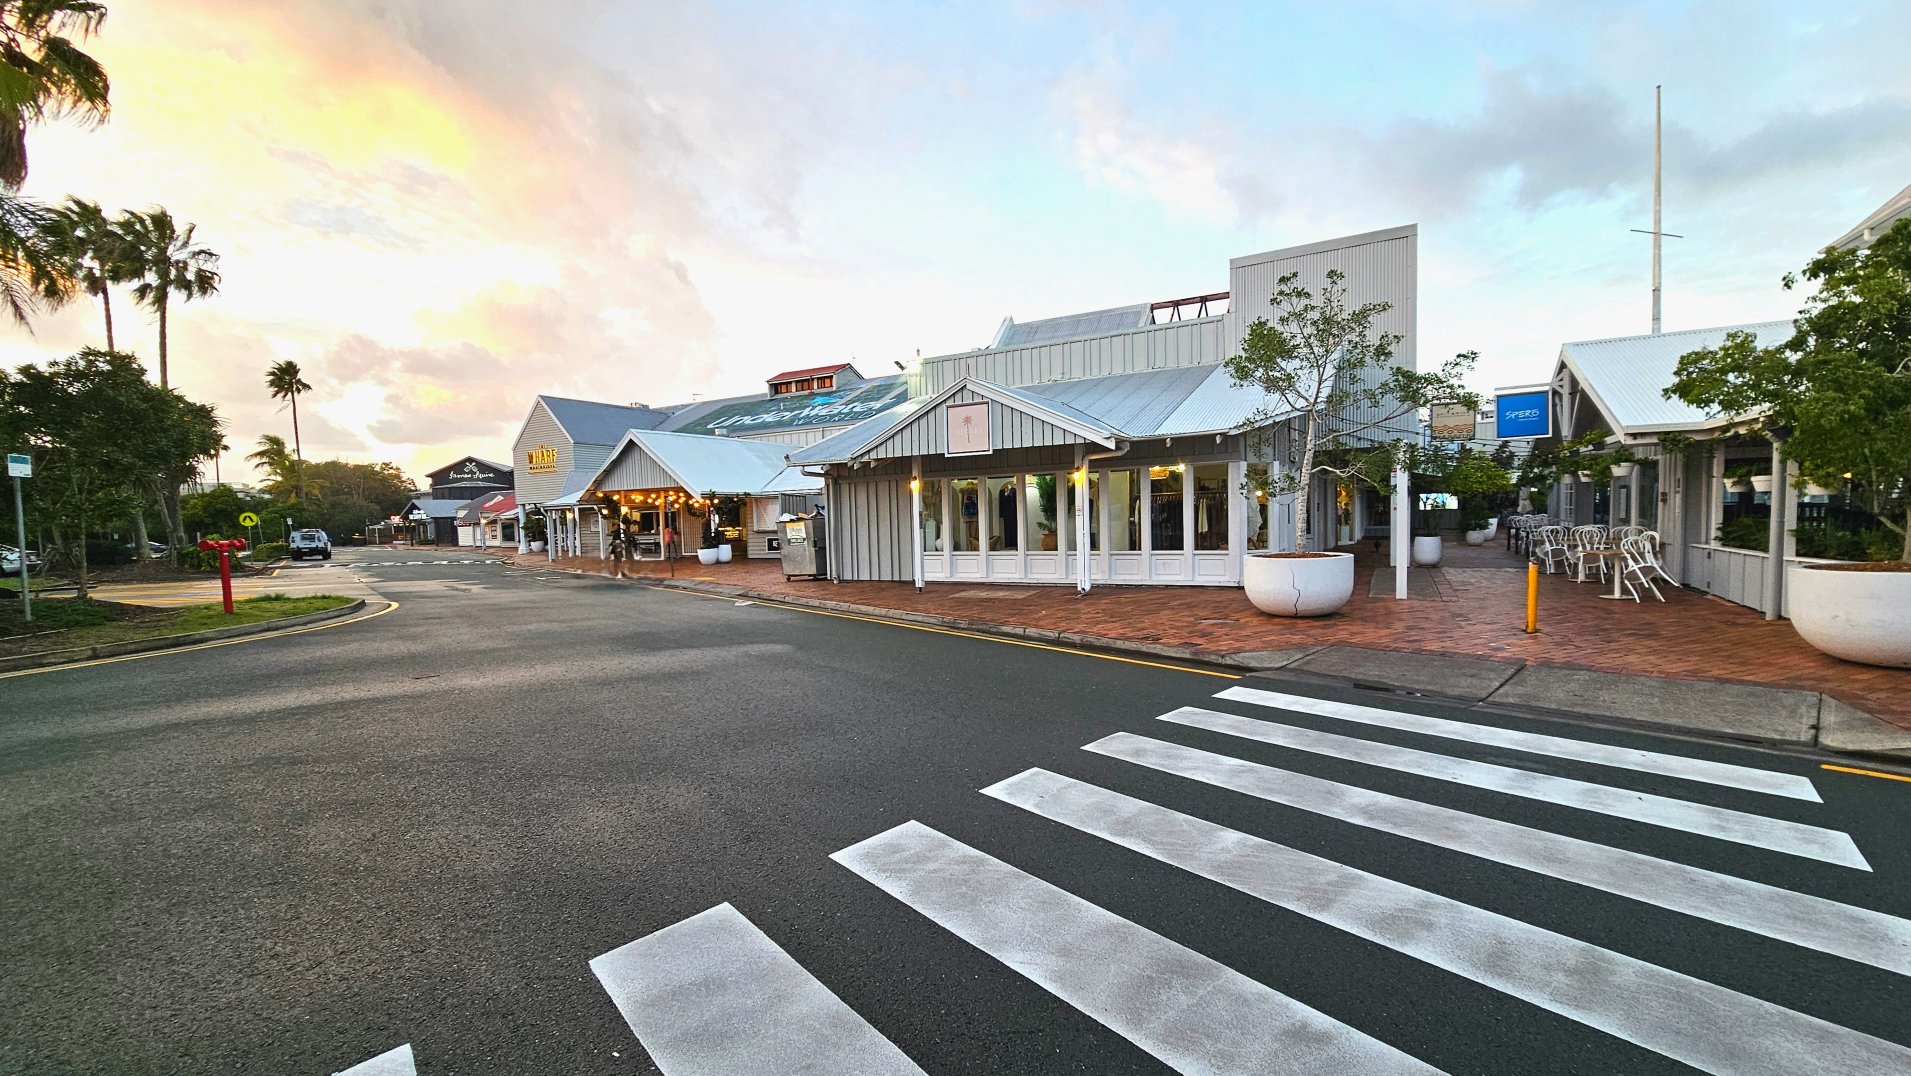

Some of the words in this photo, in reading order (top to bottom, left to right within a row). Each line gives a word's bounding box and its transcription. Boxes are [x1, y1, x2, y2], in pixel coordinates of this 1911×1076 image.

[792, 410, 876, 426] WORLD
[527, 448, 557, 464] WHARF
[449, 470, 472, 480] James
[472, 470, 495, 479] Squire
